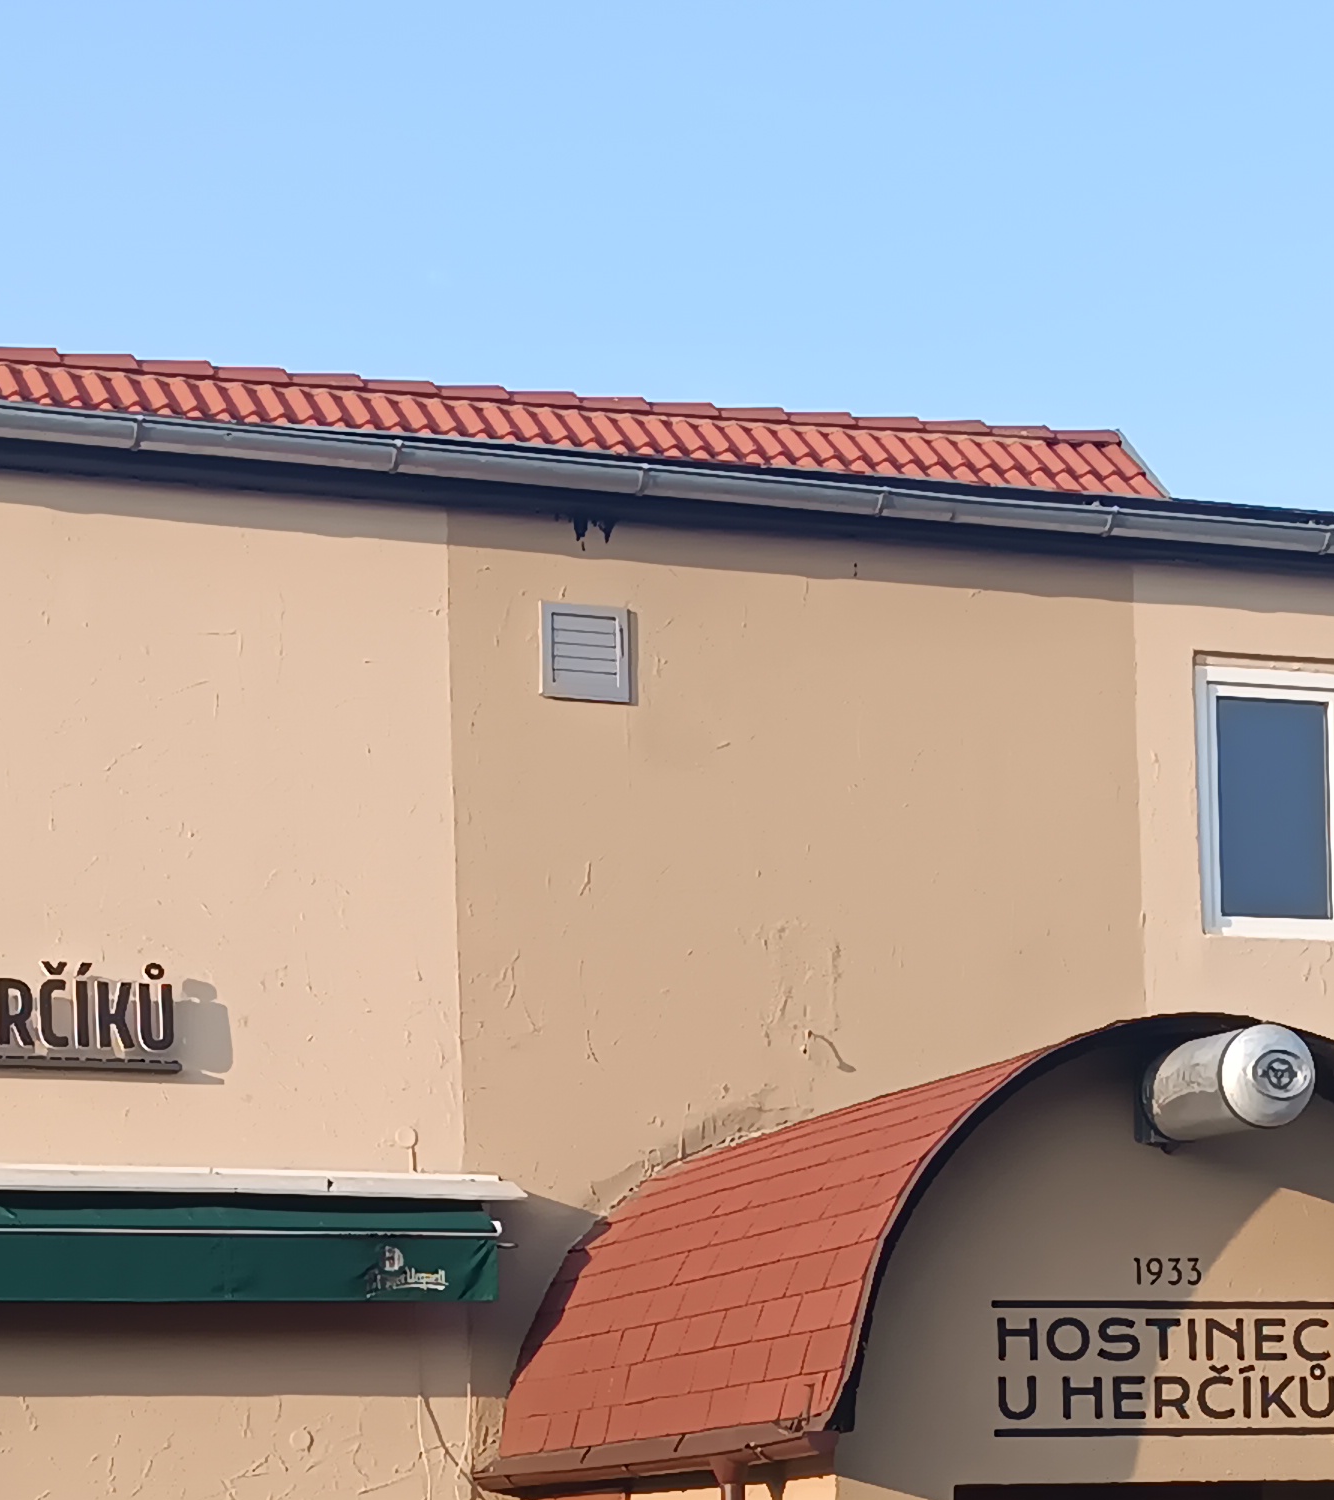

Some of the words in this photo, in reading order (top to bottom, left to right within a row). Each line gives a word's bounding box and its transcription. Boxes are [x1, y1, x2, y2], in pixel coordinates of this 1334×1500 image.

[1133, 1257, 1202, 1285] 1933
[996, 1316, 1331, 1362] HOSTINEC
[997, 1375, 1037, 1420] U
